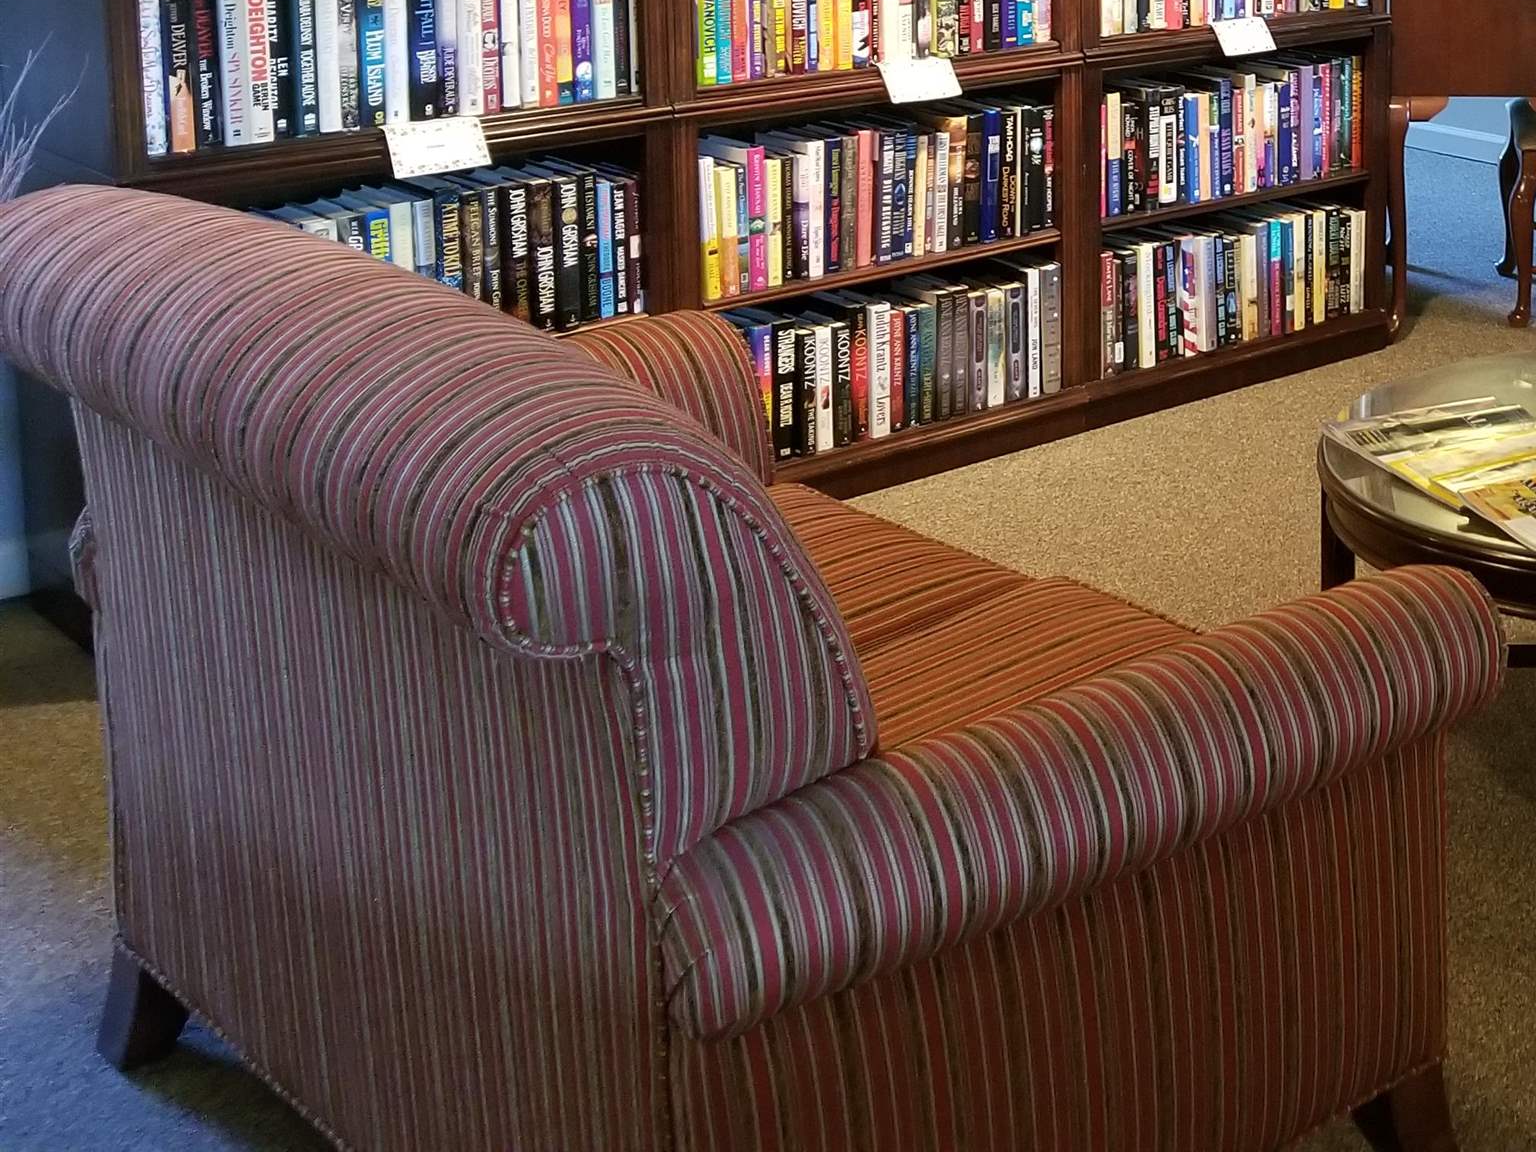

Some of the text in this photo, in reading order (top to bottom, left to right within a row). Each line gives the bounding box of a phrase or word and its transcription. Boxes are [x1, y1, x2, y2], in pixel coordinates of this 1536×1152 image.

[171, 24, 187, 68] DEAVER
[221, 4, 238, 49] Deighton
[300, 17, 312, 46] DELINSKY
[200, 73, 211, 99] Broken
[228, 52, 242, 124] SPY SINKER
[278, 57, 288, 76] LEN
[301, 49, 315, 106] TOGETHER ALONE
[366, 30, 385, 106] PLUM ISLAND
[424, 50, 436, 83] NELSON
[443, 48, 455, 106] JUDE DEVERAUX
[203, 100, 213, 130] Window
[253, 84, 261, 107] GAME
[261, 83, 269, 111] BERLIN
[1149, 106, 1159, 158] STEPHEN HUNTER
[488, 208, 497, 246] SUMMONS
[509, 188, 528, 258] JOHN GRISHAM
[560, 183, 578, 268] JOHN GRISHAM
[584, 176, 594, 230] THE TESTAMENT
[613, 190, 624, 239] JEAN HAGER
[441, 203, 462, 277] A TIME TO KILL
[470, 201, 481, 277] PELICAN BRIEF
[584, 253, 594, 273] JOHN
[490, 269, 499, 290] JOHN
[536, 245, 554, 315] JOHN GRISHAM
[602, 279, 612, 308] BOONE
[778, 329, 794, 374] STRANGERS
[804, 340, 815, 390] KOONTZ
[838, 334, 850, 383] KOONTZ
[854, 329, 867, 382] KOONTZ
[874, 310, 889, 373] Judith Krantz
[877, 396, 888, 425] Lovers
